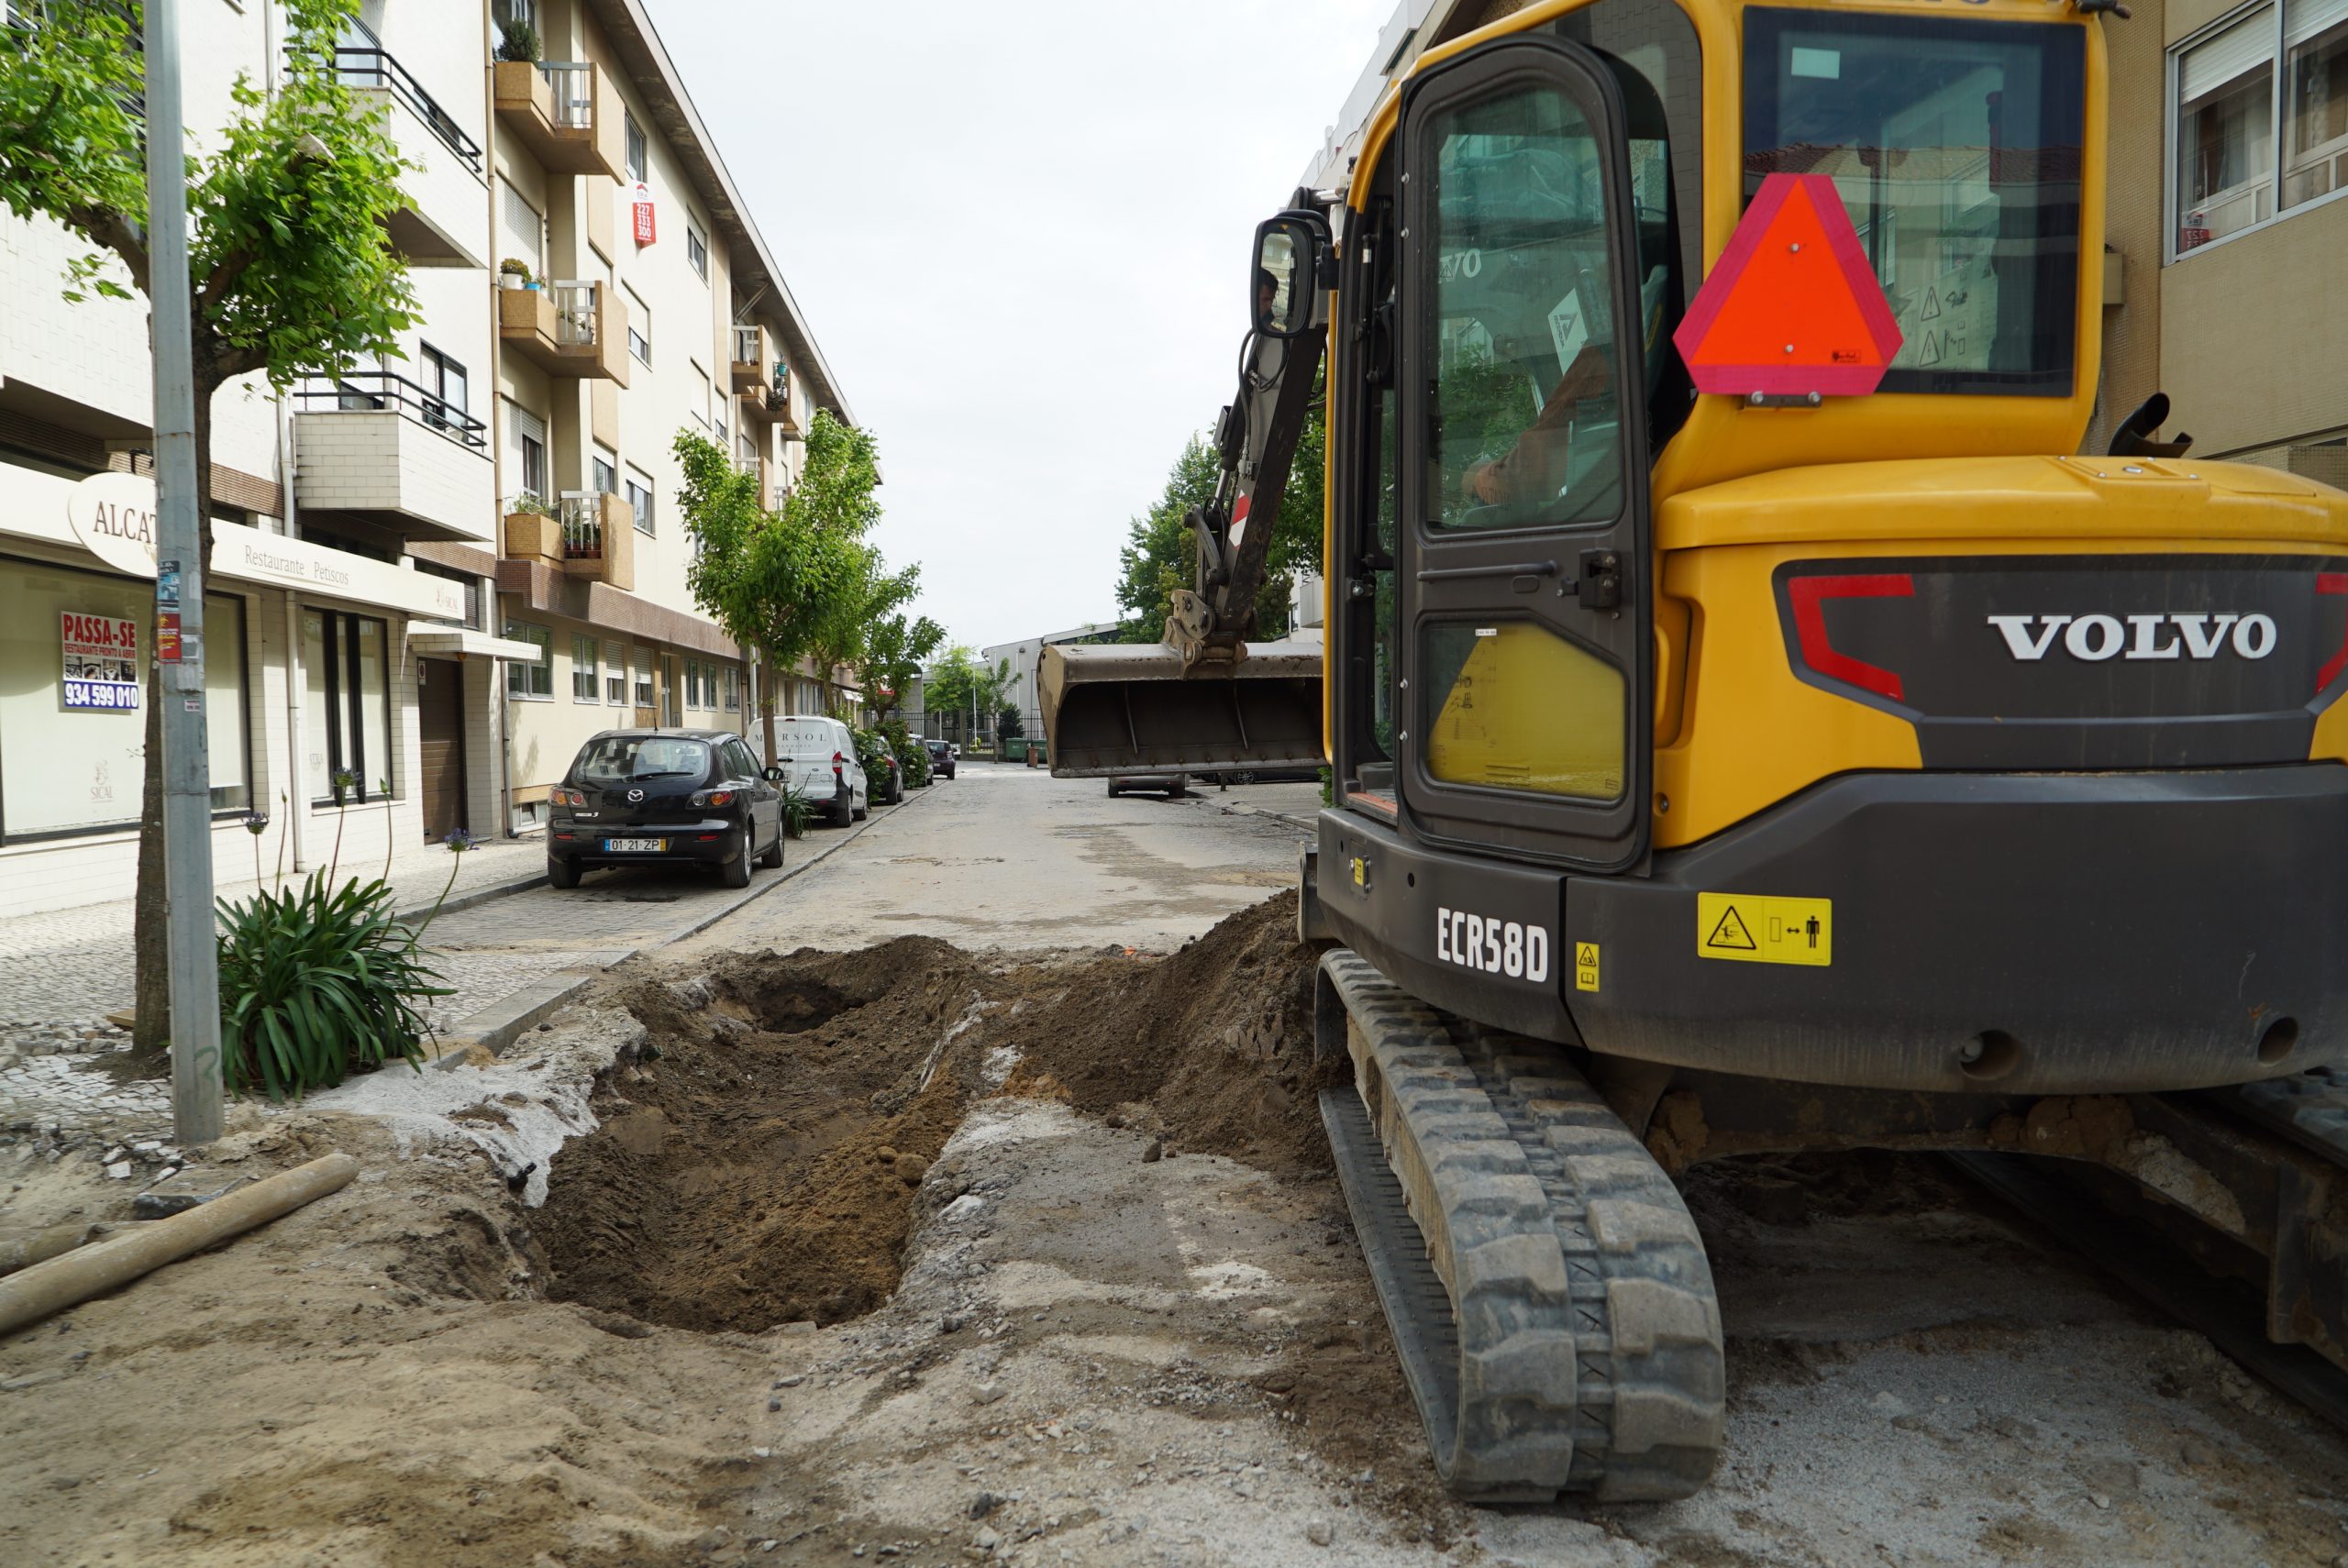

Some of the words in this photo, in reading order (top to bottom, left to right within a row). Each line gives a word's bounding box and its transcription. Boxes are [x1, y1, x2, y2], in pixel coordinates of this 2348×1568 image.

[637, 203, 650, 215] 227
[637, 214, 650, 227] 333
[637, 225, 652, 238] 300
[245, 545, 305, 576] Restaurante
[314, 561, 349, 585] Petiscos
[63, 613, 136, 647] PASSA-SE
[1987, 613, 2278, 661] VOLVO
[65, 682, 91, 705] 934
[92, 684, 116, 707] 599
[116, 686, 138, 708] 010
[755, 734, 826, 742] MRSOL
[1437, 906, 1549, 983] ECR58D
